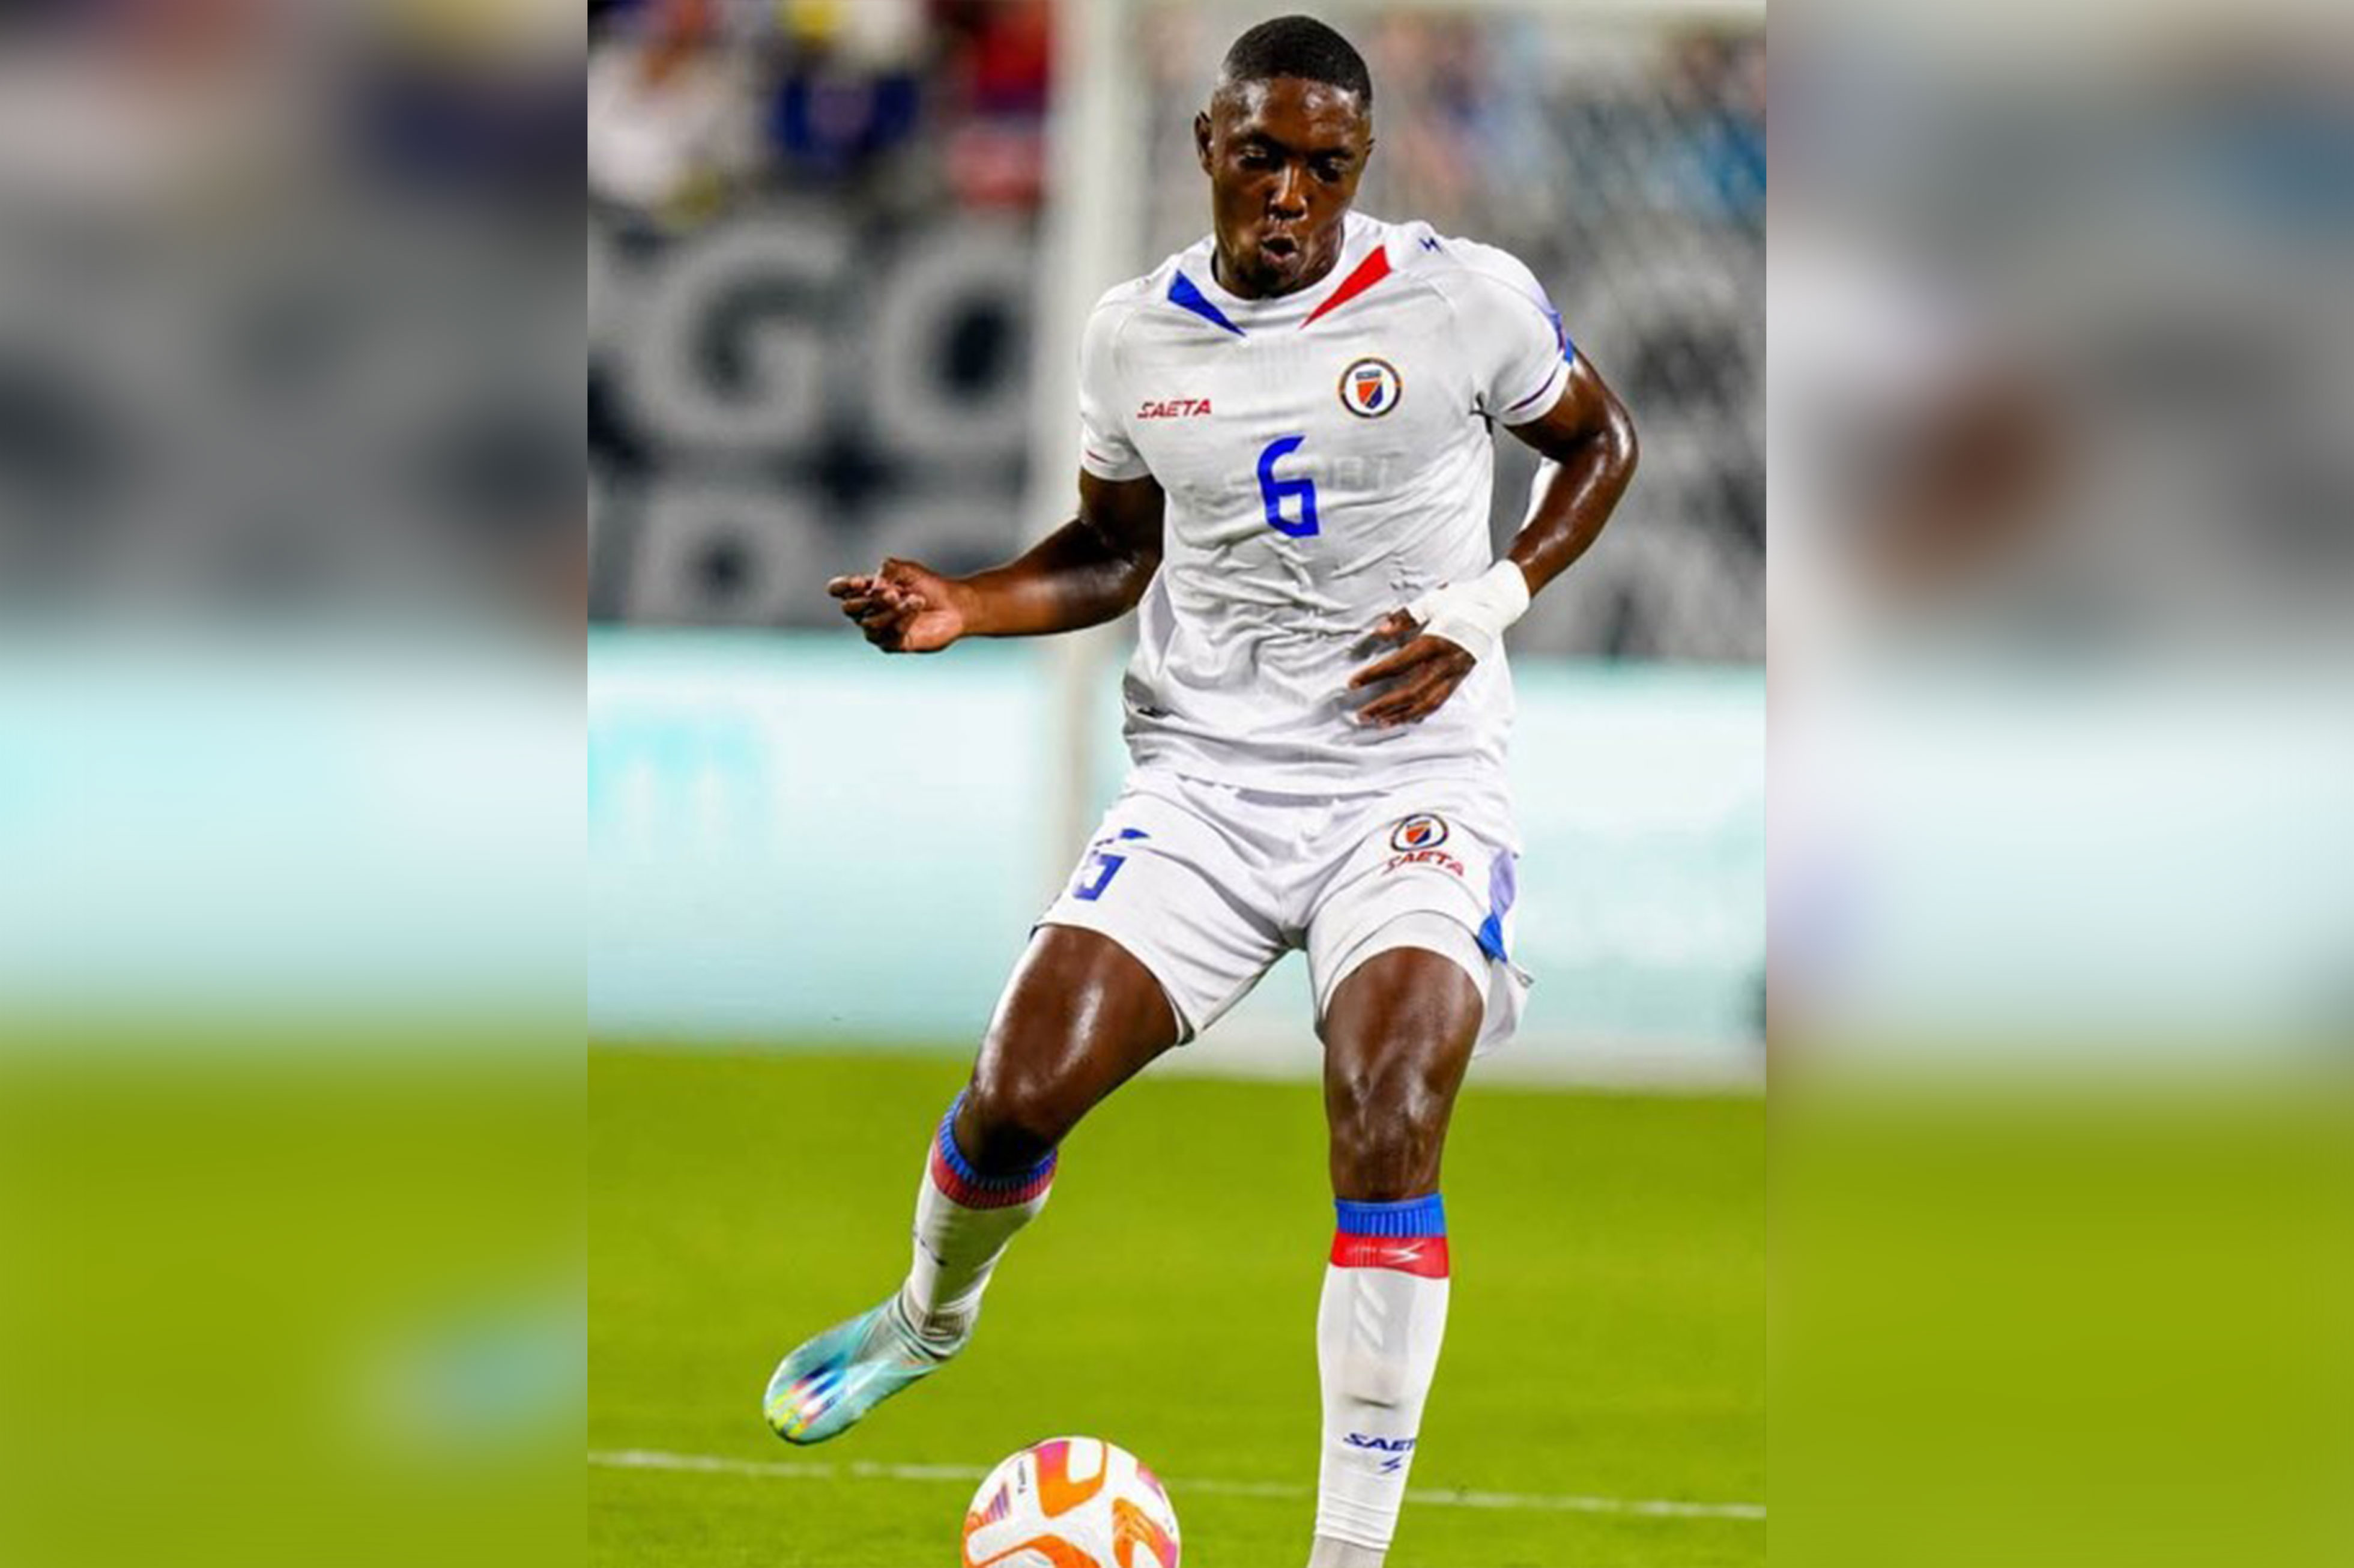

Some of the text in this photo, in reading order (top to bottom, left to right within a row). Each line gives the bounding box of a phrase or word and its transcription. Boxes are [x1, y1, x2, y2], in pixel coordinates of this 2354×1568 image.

[1137, 398, 1212, 419] SAETA
[1257, 435, 1320, 537] 6
[1382, 850, 1464, 876] SAETA
